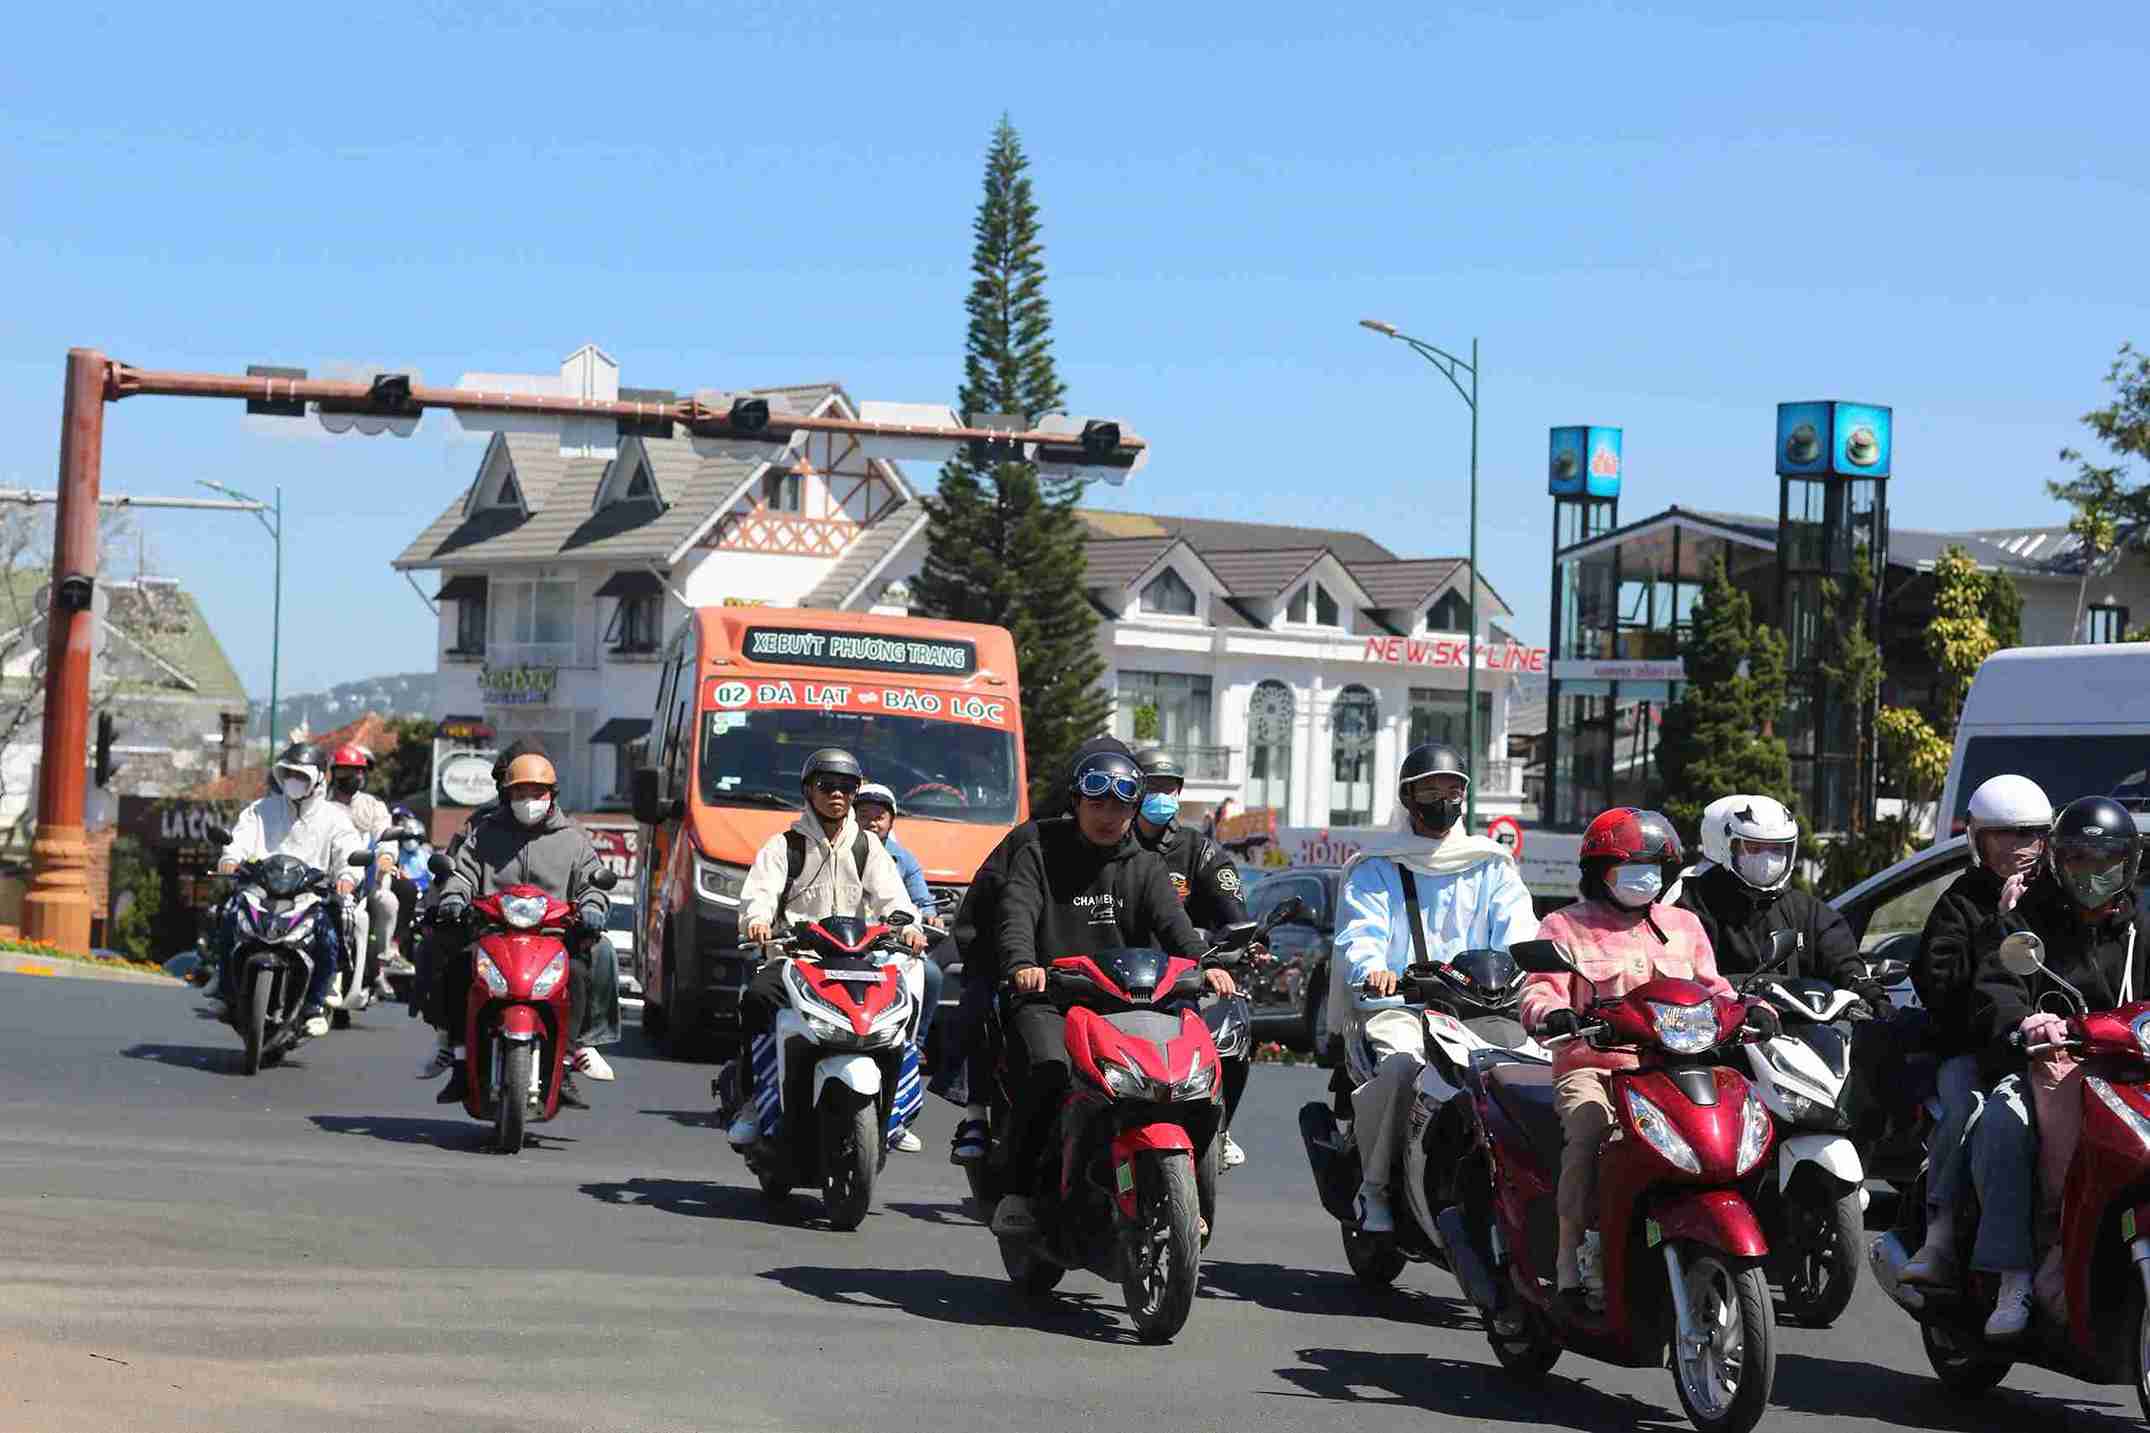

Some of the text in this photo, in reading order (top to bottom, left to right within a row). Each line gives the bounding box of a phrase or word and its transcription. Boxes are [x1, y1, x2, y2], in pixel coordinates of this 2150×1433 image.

[753, 632, 965, 668] XE BUÝT PHƯƠNG TRANG
[1364, 636, 1428, 664] NEW
[717, 681, 1005, 725] 02 ĐÀ LẠT BẢO LỘC
